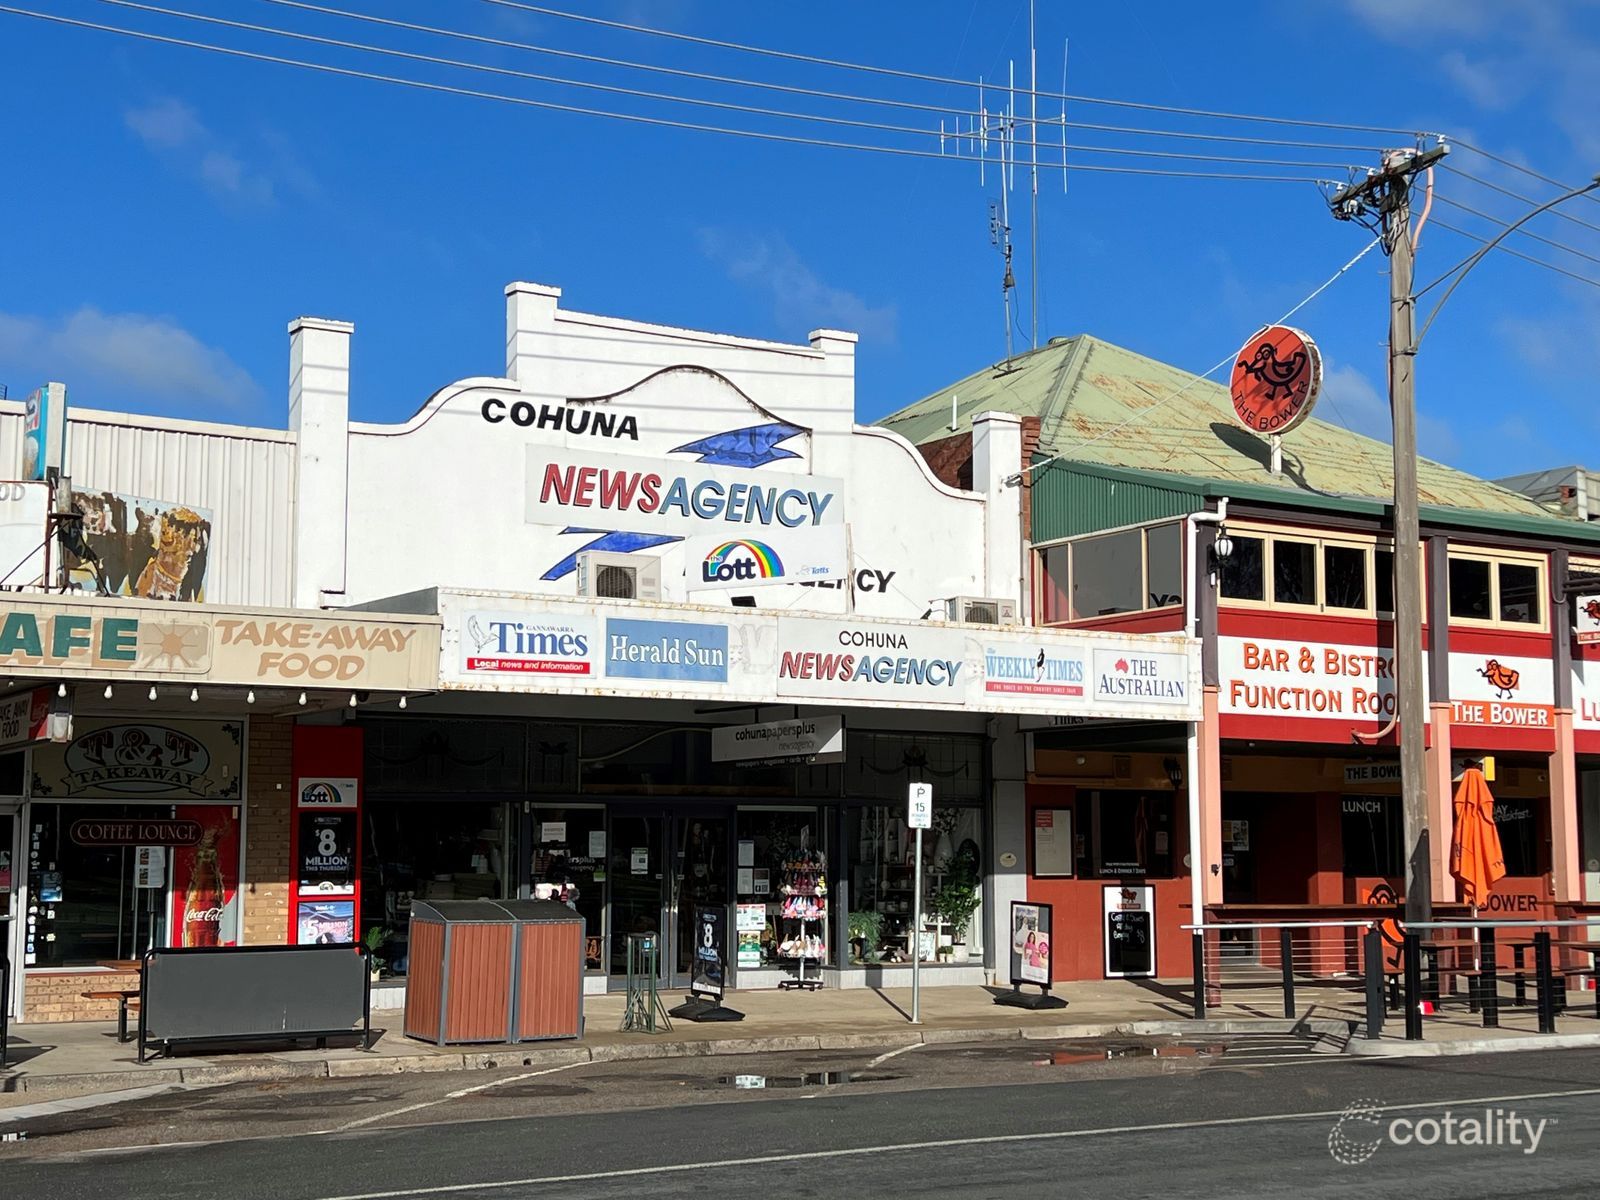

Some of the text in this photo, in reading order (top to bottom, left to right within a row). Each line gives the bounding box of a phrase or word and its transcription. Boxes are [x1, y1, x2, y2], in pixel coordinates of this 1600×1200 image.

[1234, 380, 1308, 430] THE BOWER
[481, 397, 639, 441] COHUNA
[539, 463, 834, 528] NEWSAGENCY
[702, 557, 756, 582] Lott
[811, 566, 829, 575] Tatts
[214, 619, 417, 653] TAKE-AWAY
[489, 621, 589, 657] Times
[526, 625, 575, 633] GANNAWARRA
[610, 634, 724, 667] Herald Sun
[838, 630, 909, 650] COHUNA
[257, 653, 365, 681] FOOD
[474, 659, 584, 671] Local news and information
[985, 655, 1083, 682] WEEKLY TIMES
[1130, 659, 1157, 677] THE
[1243, 642, 1289, 673] BAR
[1298, 646, 1314, 674] &
[778, 651, 963, 687] NEWSAGENCY
[1099, 673, 1184, 698] AUSTRALIAN
[1230, 679, 1396, 716] FUNCTION ROO
[1451, 703, 1549, 726] THE BOWER
[735, 722, 815, 741] cohunapapersplus
[78, 729, 199, 766] T & T
[779, 741, 815, 752] newsagency
[75, 766, 202, 786] TAKEAWAY
[1346, 767, 1369, 780] THE
[915, 802, 925, 812] 15
[1342, 801, 1381, 813] LUNCH
[1494, 804, 1508, 815] AY
[77, 823, 197, 840] COFFEE LOUNGE
[305, 856, 348, 866] MILLION
[184, 907, 223, 922] Coca-Col
